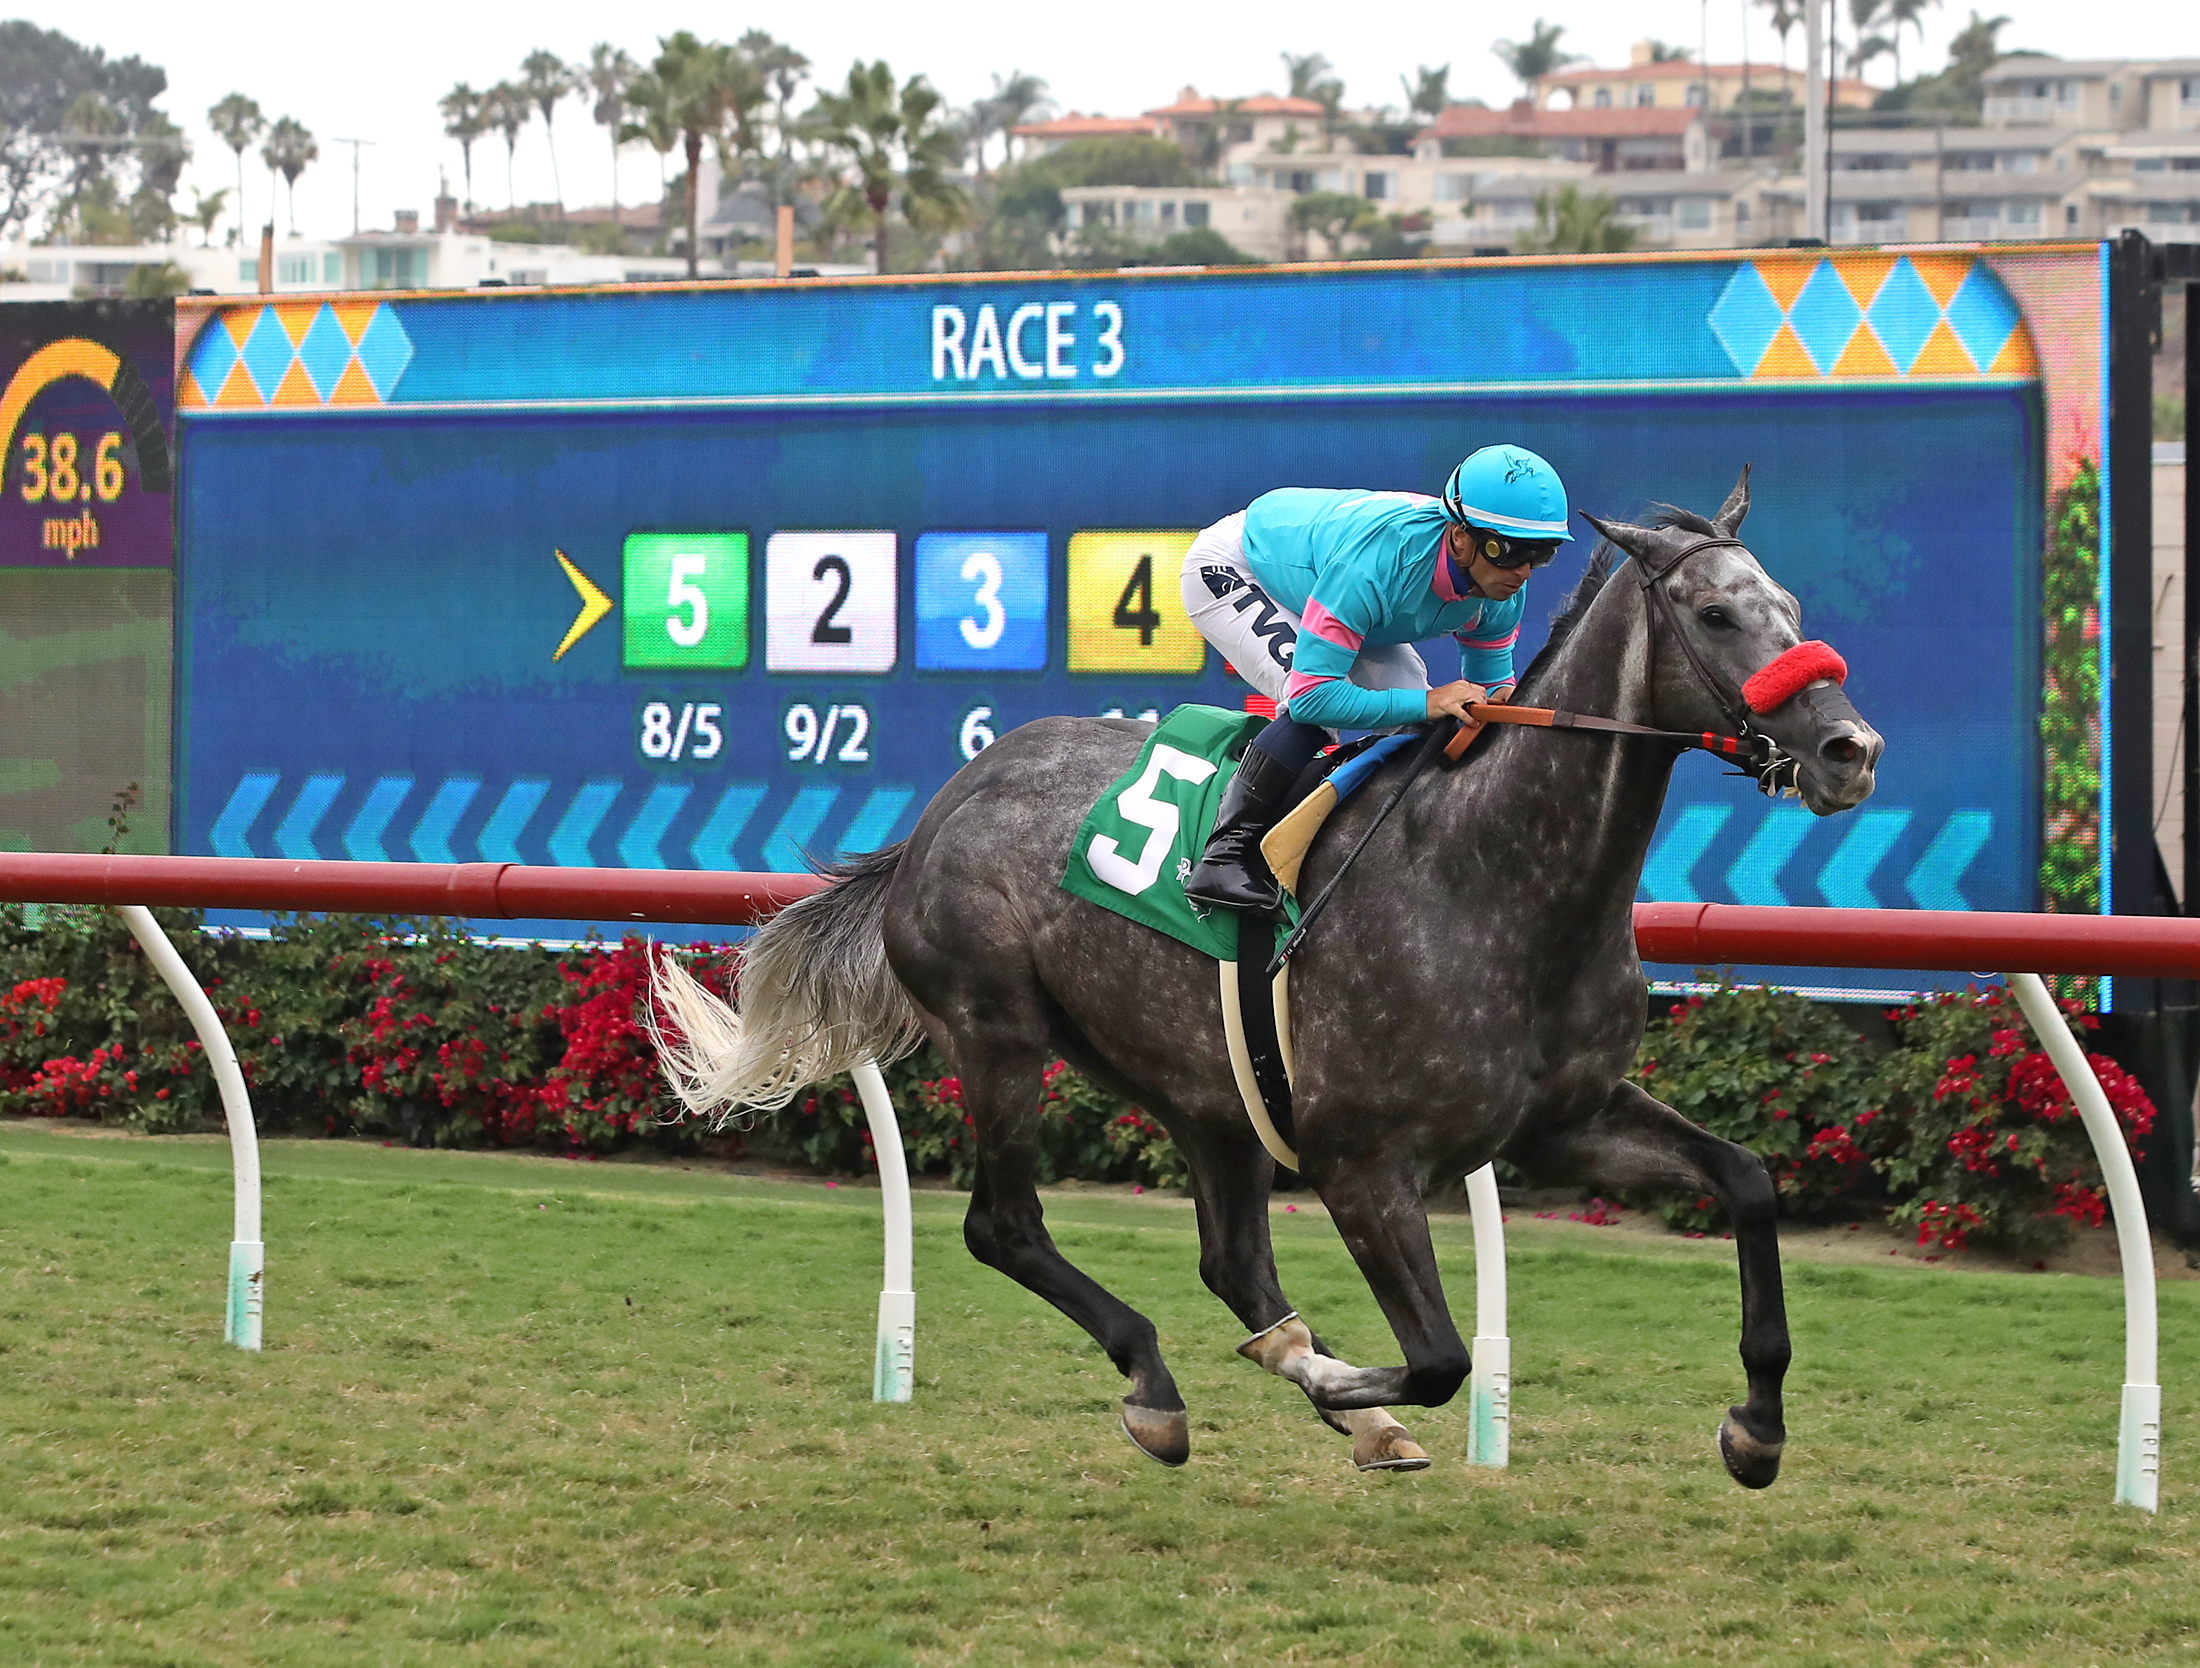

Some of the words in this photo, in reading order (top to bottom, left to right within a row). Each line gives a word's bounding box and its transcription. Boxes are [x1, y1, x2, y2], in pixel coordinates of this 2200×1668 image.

[932, 302, 1079, 380] RACE
[1092, 302, 1125, 377] 3
[21, 432, 124, 502] 38.6
[43, 508, 100, 560] mph
[666, 554, 708, 646] 5
[812, 554, 853, 644] 2
[960, 553, 1005, 648] 3
[1114, 554, 1160, 646] 4
[1233, 583, 1297, 674] TVG
[640, 702, 722, 760] 8/5
[784, 704, 870, 764] 9/2
[960, 706, 995, 761] 6
[1087, 744, 1217, 895] 5
